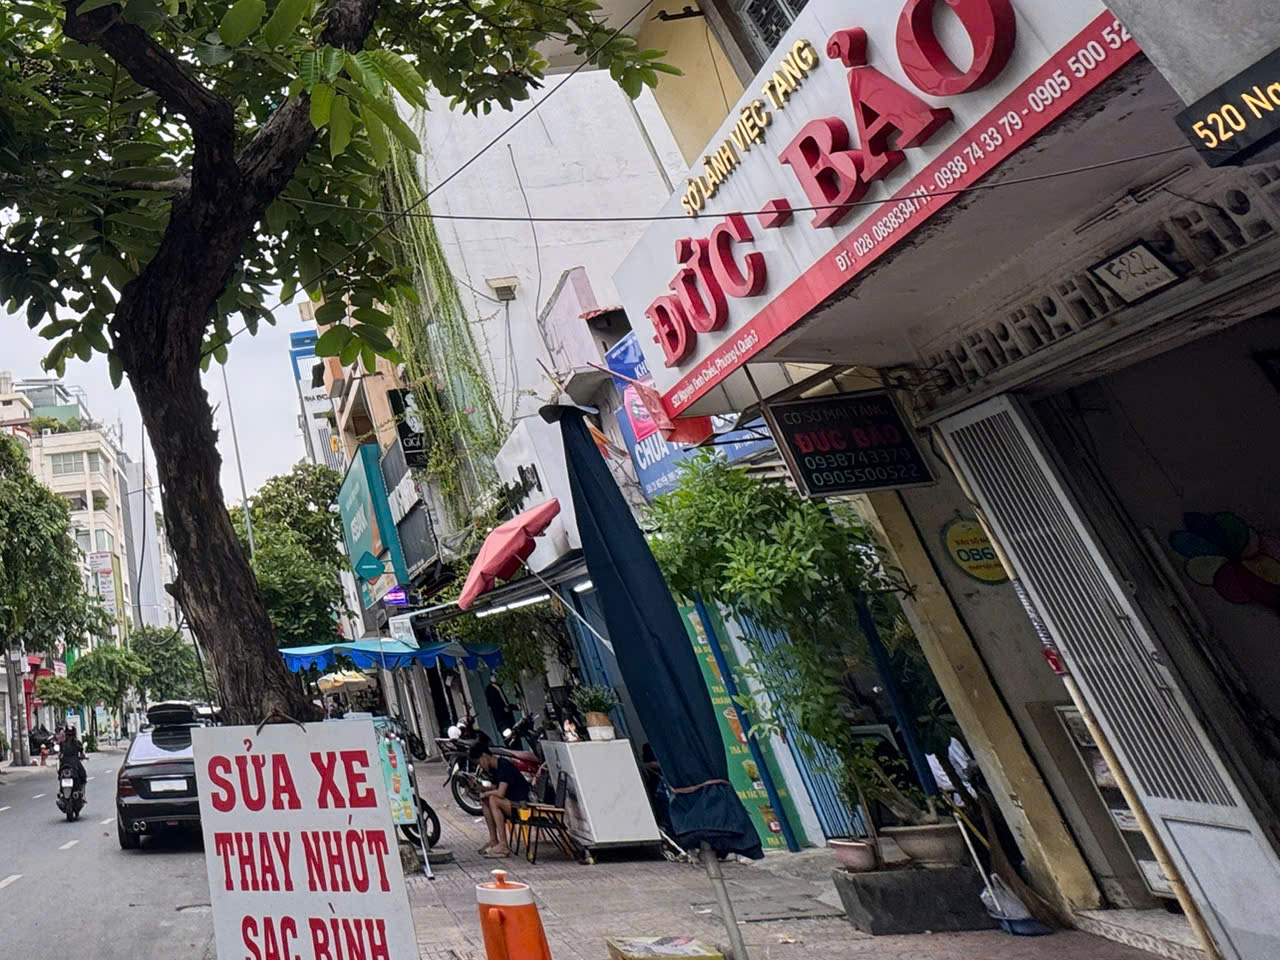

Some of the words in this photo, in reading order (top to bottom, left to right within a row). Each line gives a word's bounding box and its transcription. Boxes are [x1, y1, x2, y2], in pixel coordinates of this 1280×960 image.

[730, 99, 771, 152] VIỆC
[761, 39, 819, 111] TANG
[934, 155, 968, 190] 0938
[963, 145, 984, 167] 74
[980, 127, 1003, 152] 33
[998, 110, 1023, 137] 79
[1027, 69, 1070, 113] 0905
[1067, 40, 1107, 79] 500
[1101, 19, 1132, 51] 52
[1192, 103, 1246, 149] 520
[645, 212, 767, 368] ĐỨC
[1104, 250, 1160, 285] 522
[207, 738, 302, 813] SỬA
[310, 750, 378, 809] XE
[214, 830, 294, 892] THAY
[300, 814, 391, 894] NHỚT
[308, 902, 391, 960] BÌNH
